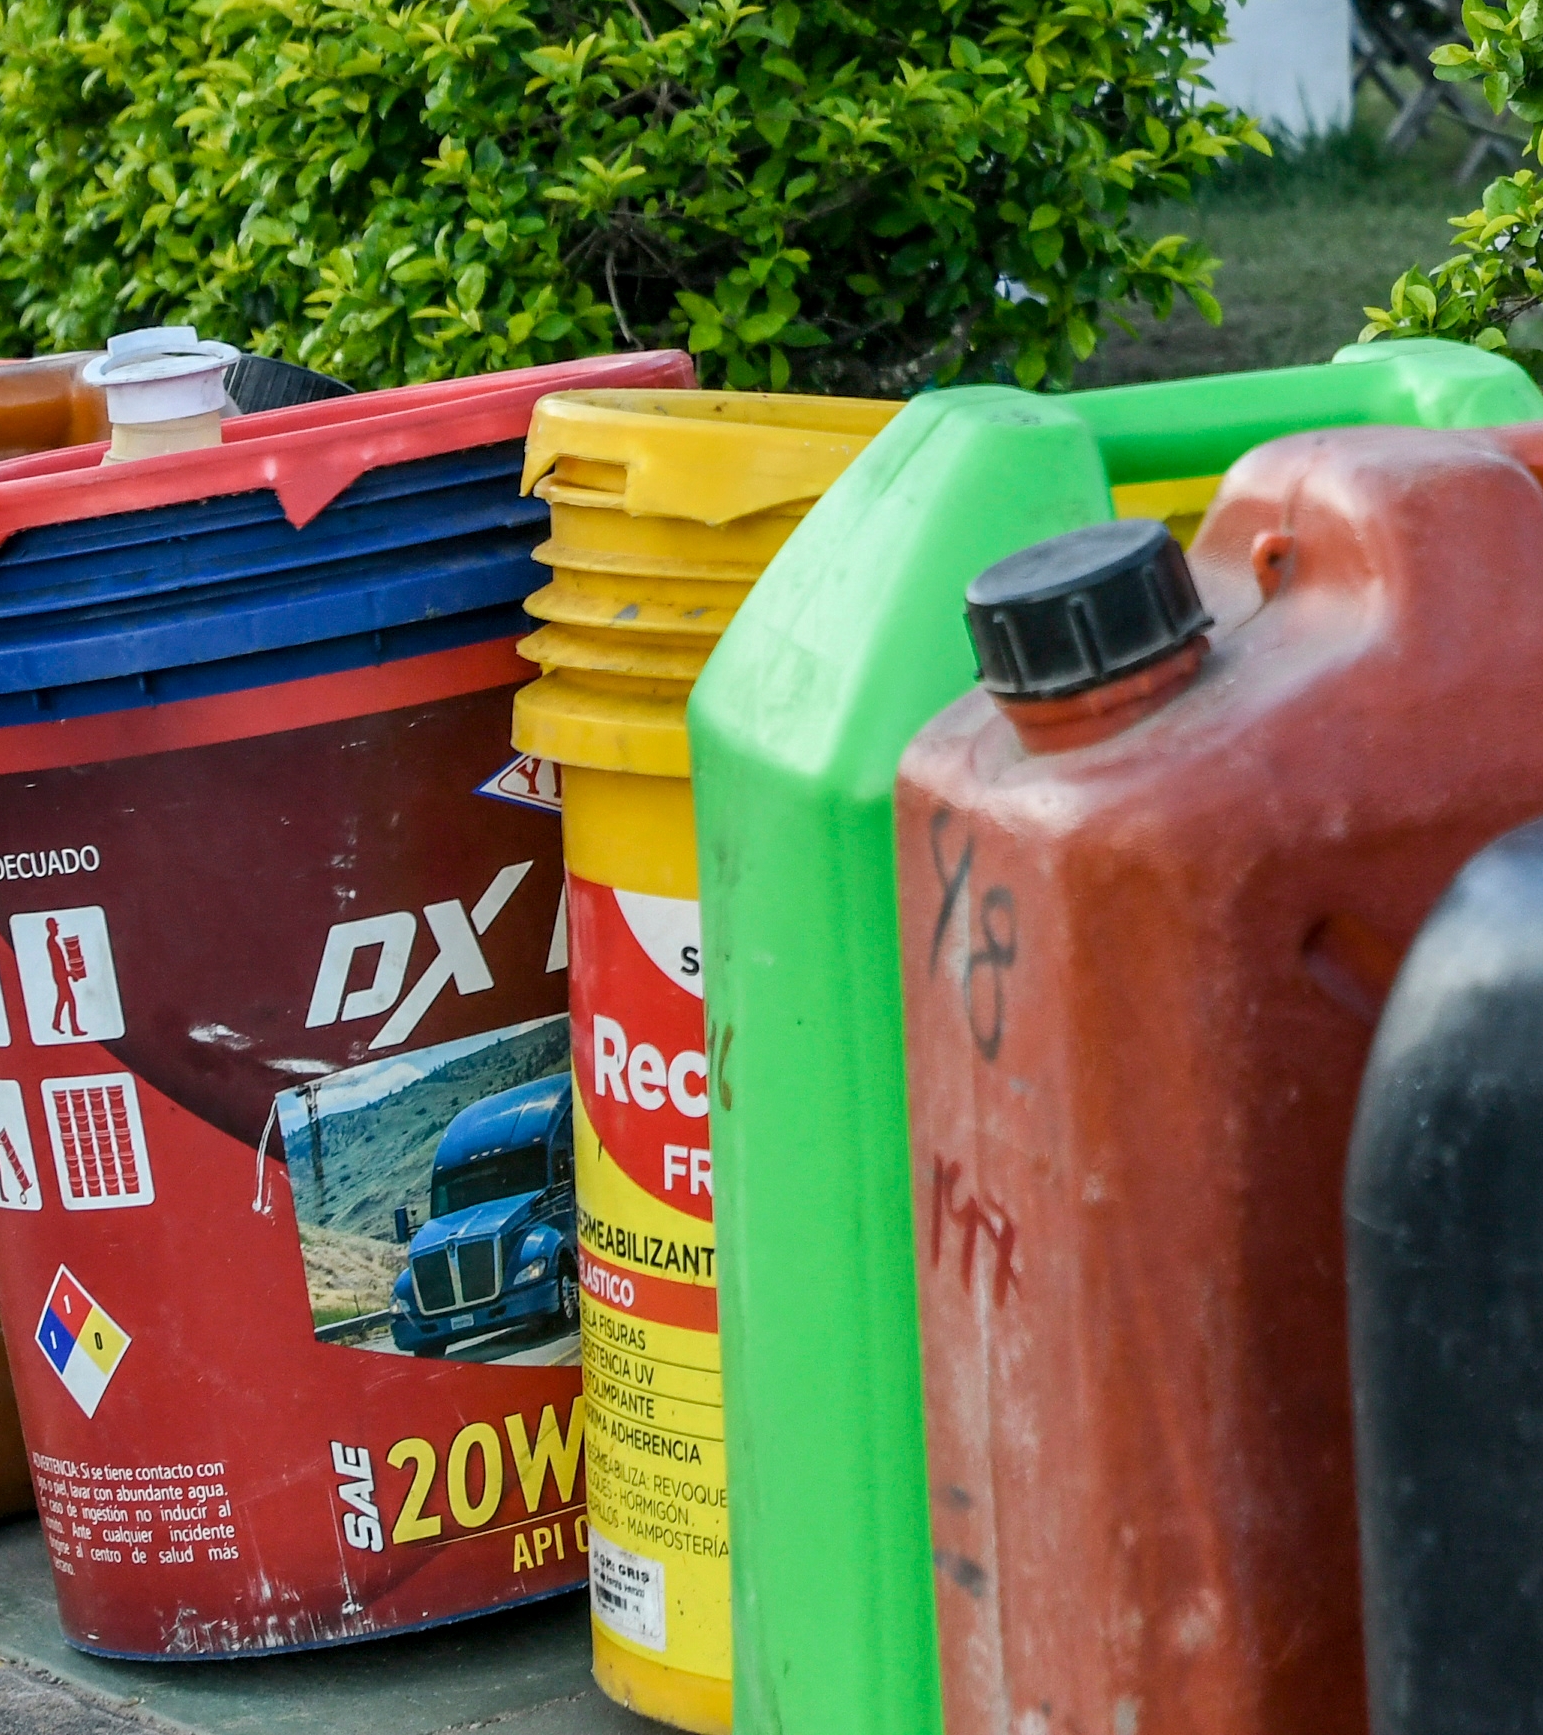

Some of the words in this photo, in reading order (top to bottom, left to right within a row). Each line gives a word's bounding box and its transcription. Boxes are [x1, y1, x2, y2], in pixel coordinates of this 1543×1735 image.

[304, 859, 535, 1052] DX
[592, 1013, 709, 1119] Rec
[662, 1142, 714, 1198] FR
[63, 1294, 72, 1315] 1
[50, 1330, 58, 1350] 1
[94, 1331, 103, 1351] 0
[599, 1314, 647, 1352] FISURAS
[634, 1361, 655, 1388] UV
[610, 1419, 703, 1467] ADHERENCIA
[91, 1467, 103, 1481] se
[105, 1463, 134, 1481] tiene
[135, 1464, 194, 1482] contacto
[196, 1461, 225, 1478] con
[386, 1394, 586, 1546] 20W
[69, 1480, 91, 1500] lavar
[93, 1486, 113, 1502] con
[116, 1483, 184, 1502] abundante
[187, 1481, 228, 1504] agua.
[330, 1439, 385, 1554] SAE
[653, 1473, 728, 1510] REVOQUE
[48, 1499, 64, 1515] caso
[66, 1500, 78, 1518] de
[81, 1503, 129, 1526] ingestión
[136, 1508, 152, 1523] no
[159, 1501, 208, 1522] inducir
[218, 1499, 233, 1519] al
[71, 1521, 93, 1541] Ante
[102, 1525, 154, 1547] cualquier
[168, 1522, 236, 1543] incidente
[512, 1521, 566, 1574] API
[75, 1541, 84, 1559] al
[90, 1546, 122, 1565] centro
[131, 1547, 148, 1565] de
[158, 1545, 195, 1565] salud
[207, 1541, 240, 1562] más
